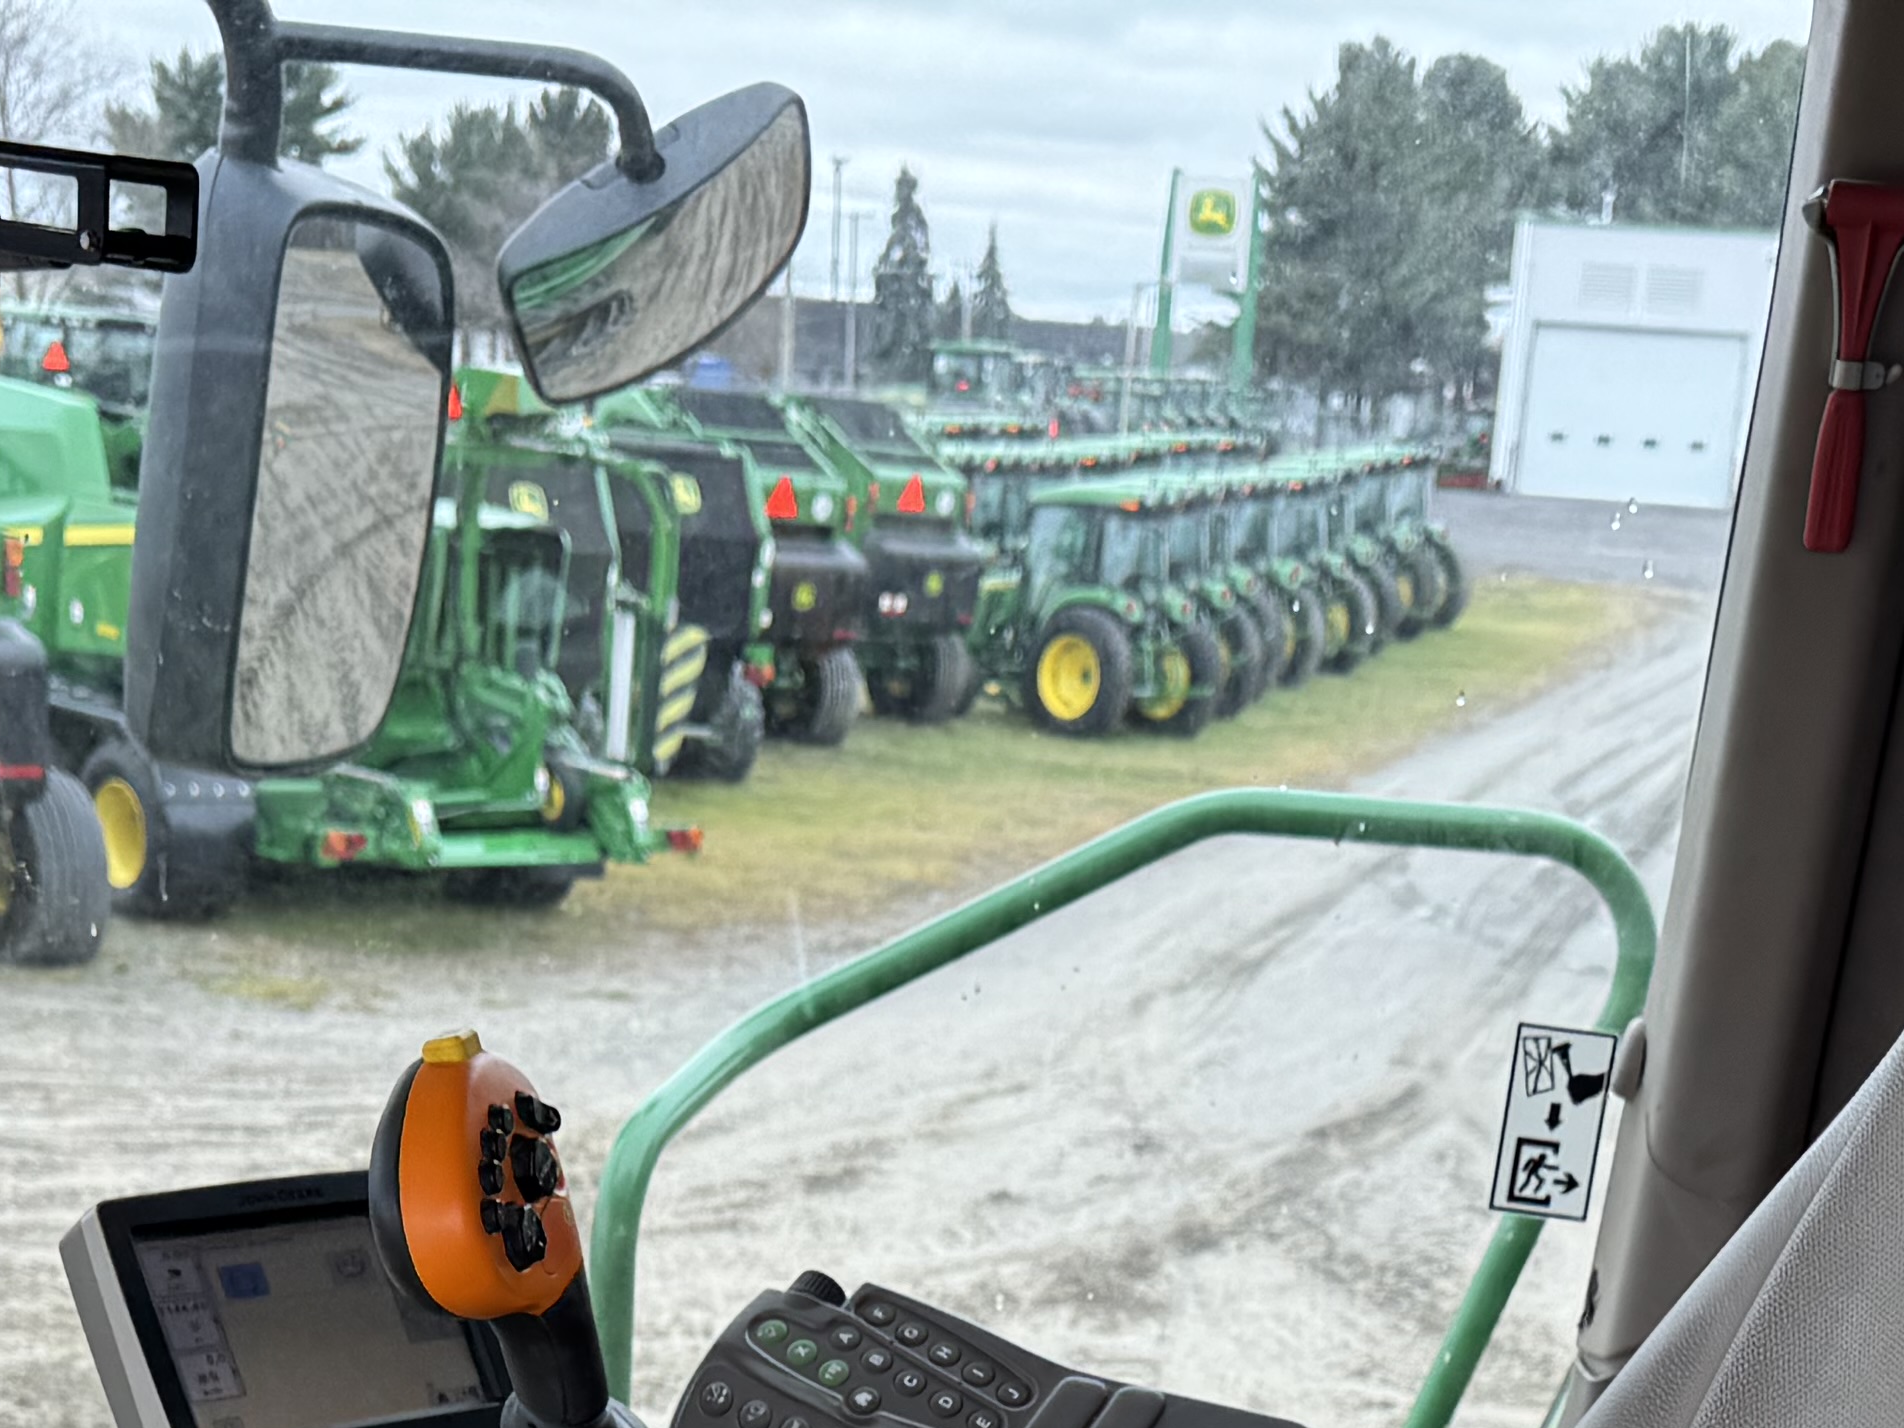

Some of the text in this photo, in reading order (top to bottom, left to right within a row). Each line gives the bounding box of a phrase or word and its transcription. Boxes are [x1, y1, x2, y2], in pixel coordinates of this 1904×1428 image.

[839, 1331, 853, 1345] A
[869, 1353, 884, 1367] B
[903, 1375, 918, 1388] C
[938, 1396, 953, 1410] D
[937, 1345, 953, 1361] H
